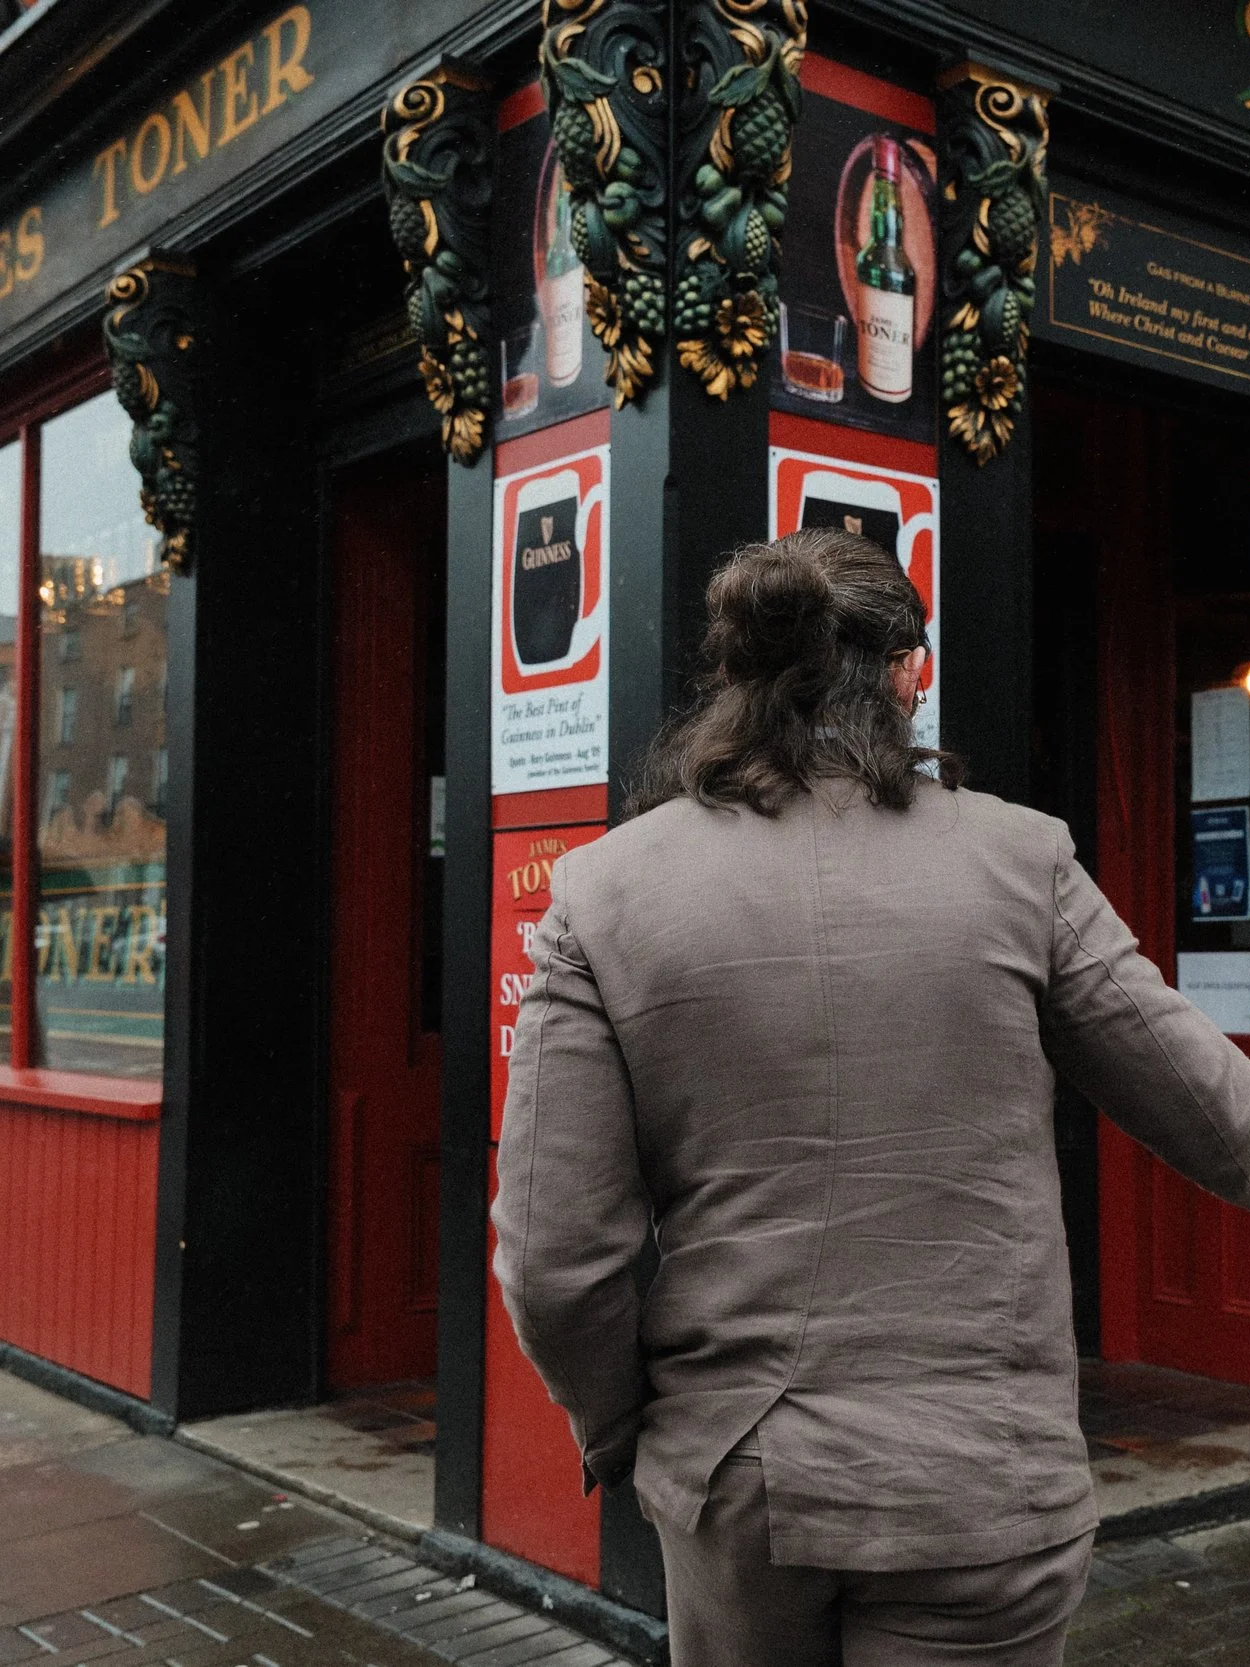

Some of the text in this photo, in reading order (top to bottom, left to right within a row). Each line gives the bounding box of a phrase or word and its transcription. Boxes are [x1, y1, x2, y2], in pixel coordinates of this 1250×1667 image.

[92, 4, 315, 229] TONER
[1089, 300, 1132, 328] Where
[1133, 314, 1176, 341] Christ
[1177, 331, 1205, 348] and
[1118, 286, 1169, 316] Ireland
[1170, 307, 1191, 325] my
[1192, 309, 1220, 331] first
[1220, 322, 1248, 340] and
[859, 319, 911, 345] TONER
[521, 540, 572, 571] GUINNESS
[525, 702, 545, 719] Best
[546, 698, 570, 715] Pint
[571, 692, 584, 717] of
[501, 728, 543, 745] Guinness
[545, 727, 556, 739] in
